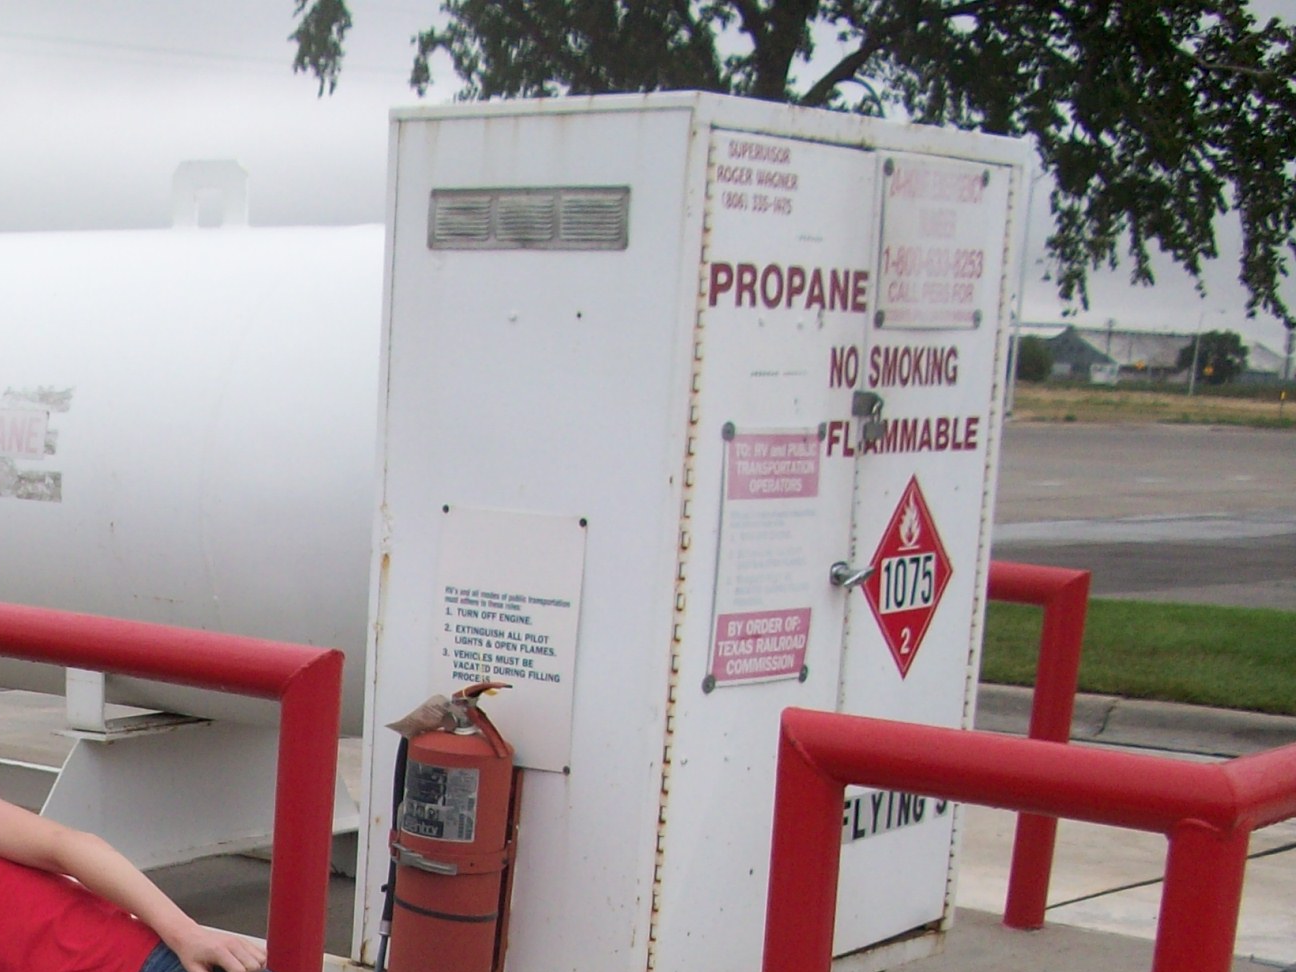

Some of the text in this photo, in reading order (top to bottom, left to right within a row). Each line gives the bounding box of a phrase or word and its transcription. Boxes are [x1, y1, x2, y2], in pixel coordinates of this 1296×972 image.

[728, 139, 791, 164] SUPERVISOR
[717, 164, 753, 185] ROGER
[709, 262, 869, 313] PROPANE
[830, 345, 958, 389] NO SMOKING
[749, 478, 802, 493] OPERATORS
[884, 555, 933, 610] 1075
[457, 608, 478, 619] TURN
[481, 611, 497, 621] OFF
[499, 613, 533, 625] ENGINE.
[727, 621, 743, 637] BY
[746, 618, 783, 636] ORDER
[444, 623, 549, 645] 2. EXTINGUISH ALL PILOT
[900, 627, 911, 654] 2
[455, 636, 557, 658] LIGHTS & OPEN FLAMES.
[718, 634, 805, 657] TEXAS RAILROAD
[495, 654, 519, 666] MUST
[522, 658, 534, 669] BE
[726, 654, 795, 675] COMMISSION
[493, 664, 526, 679] DURING
[528, 670, 561, 684] FILLING
